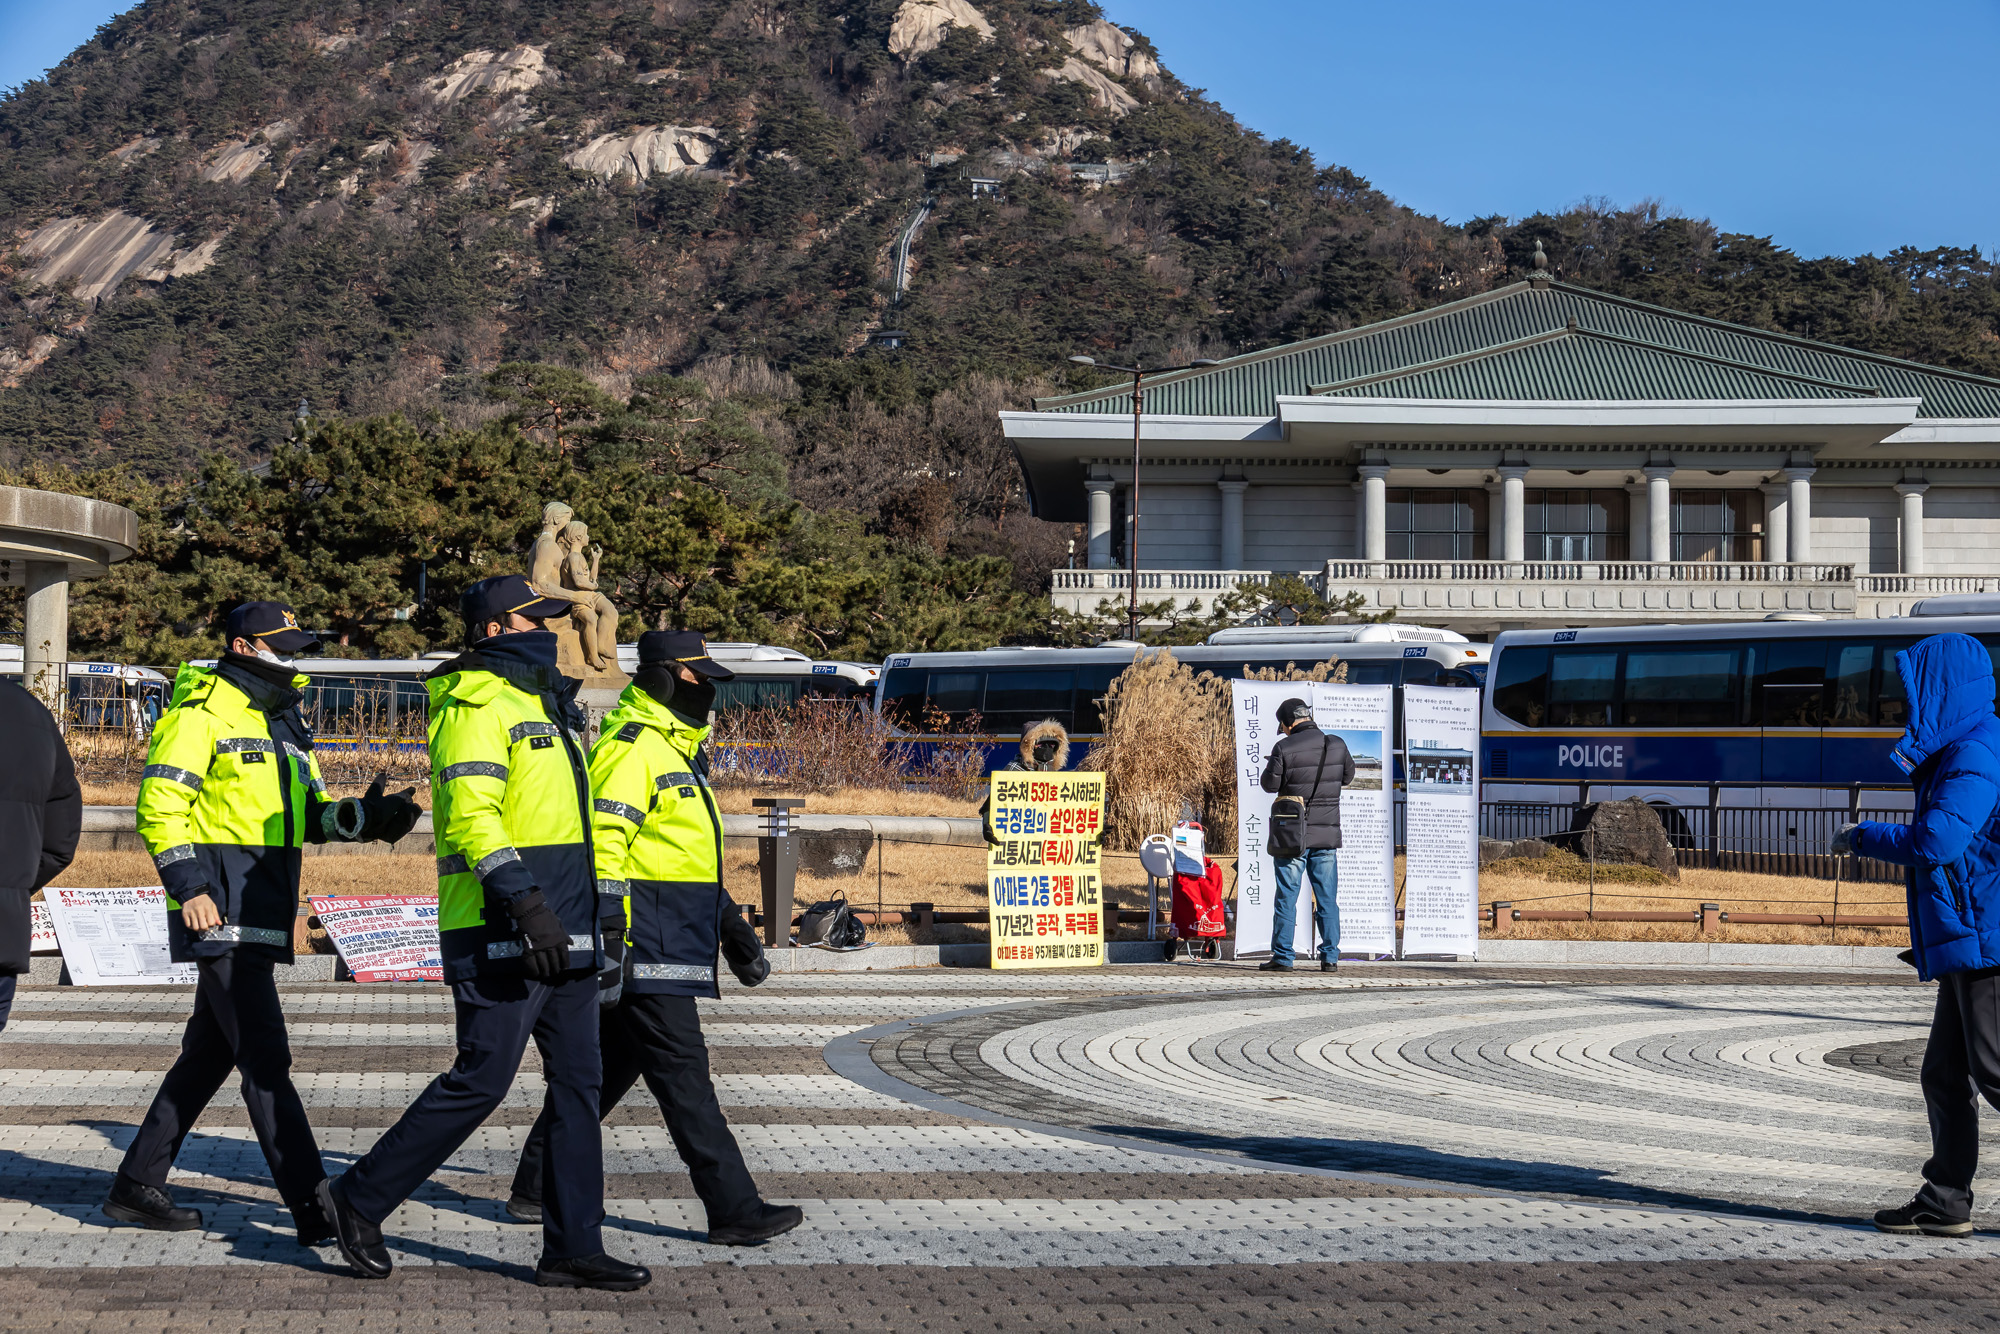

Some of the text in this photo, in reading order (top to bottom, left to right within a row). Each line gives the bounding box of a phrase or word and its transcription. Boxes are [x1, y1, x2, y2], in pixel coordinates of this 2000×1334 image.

[1244, 695, 1262, 787] 대통령님
[1558, 744, 1623, 768] POLICE
[997, 781, 1101, 802] 공수처 531호 수사하라!
[996, 808, 1099, 834] 국정원의 살인청부
[993, 840, 1097, 866] 교통사고(즉사) 시도
[1245, 813, 1262, 906] 순국선열
[59, 890, 74, 898] KT
[994, 875, 1098, 907] 아파트 2동 강탈 시도
[313, 898, 363, 913] 이재명
[320, 911, 349, 925] GS건설
[333, 918, 362, 930] GS건설
[996, 912, 1099, 937] 17년간 공작, 독극물
[338, 933, 365, 946] 이재명
[997, 943, 1100, 960] 아파트 공실 95개월째 (2월 기준)
